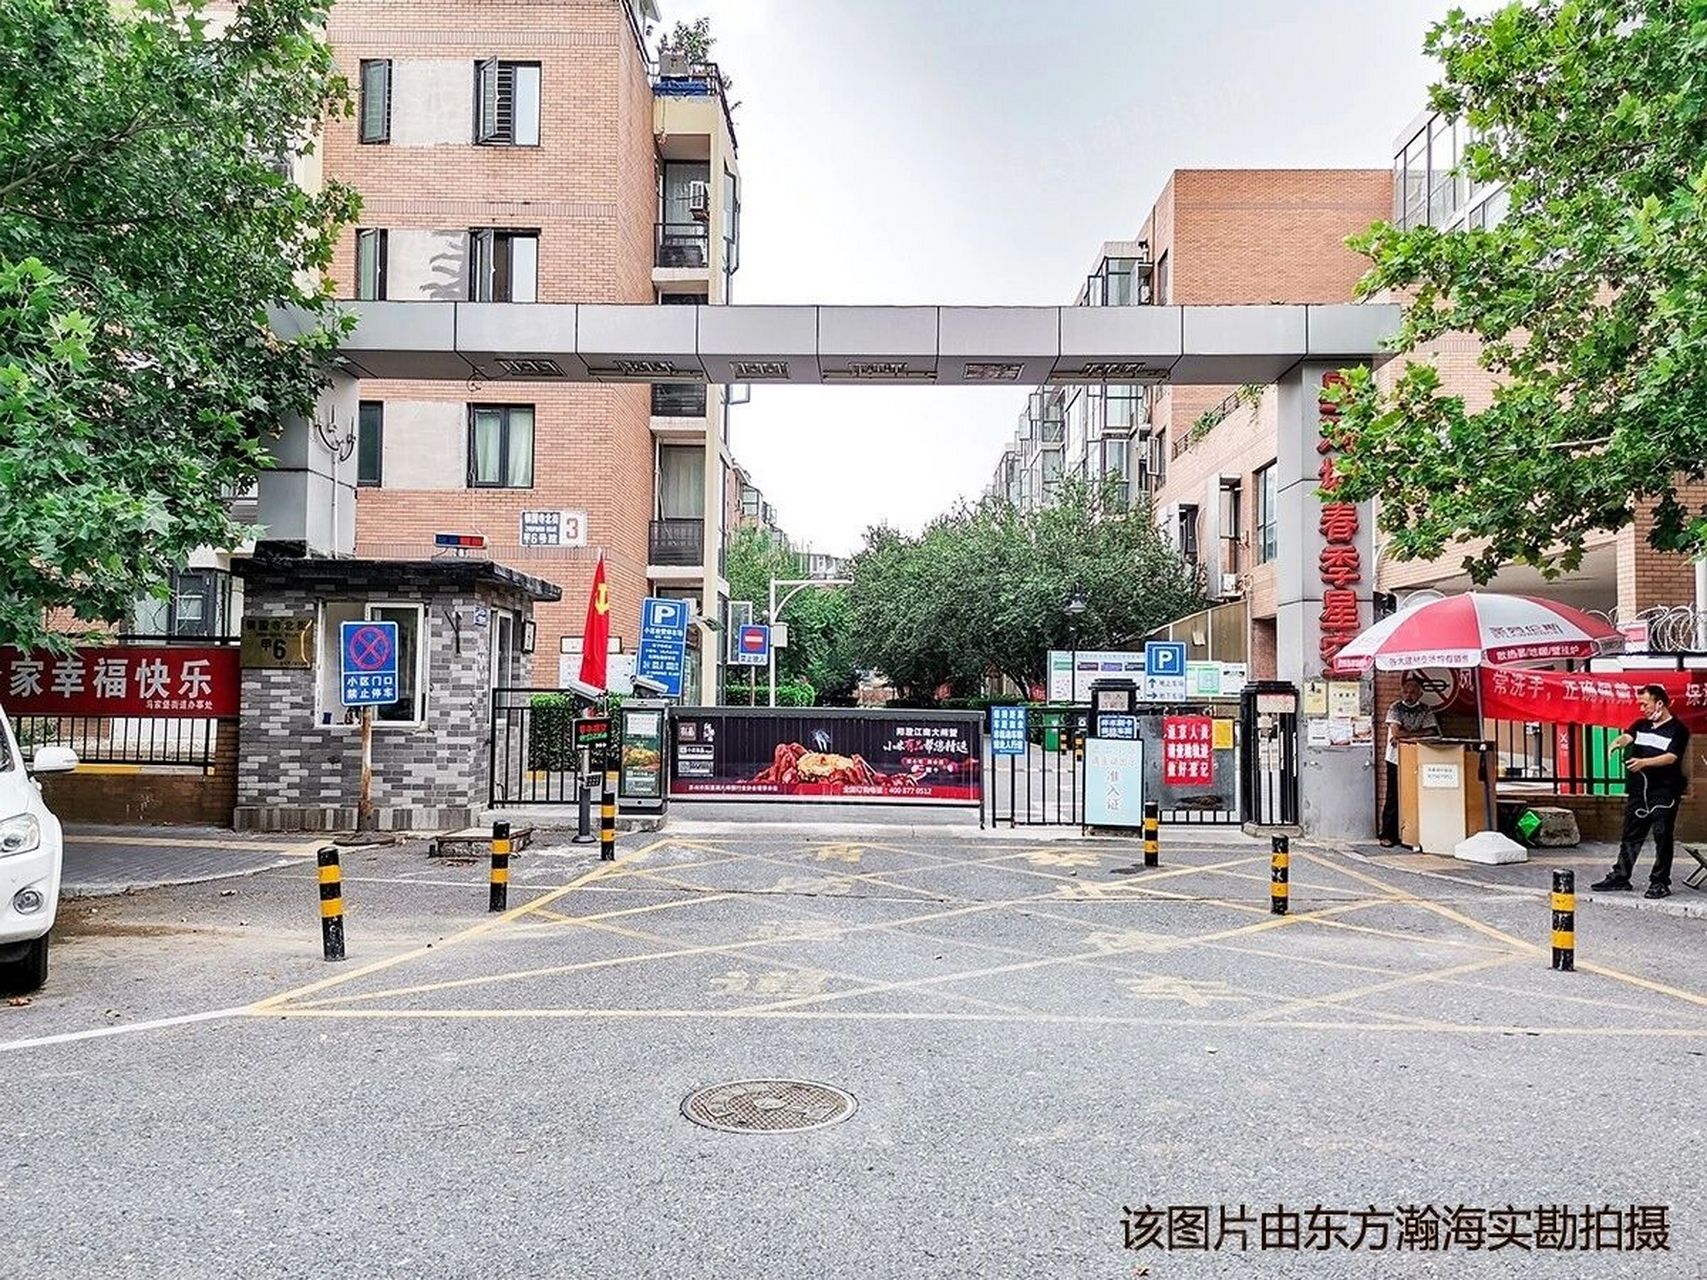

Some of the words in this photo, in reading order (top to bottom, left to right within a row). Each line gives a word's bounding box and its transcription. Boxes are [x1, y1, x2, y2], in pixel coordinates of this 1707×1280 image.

[566, 518, 578, 539] 3
[654, 605, 676, 624] P
[1159, 650, 1173, 669] P
[1, 657, 213, 698] 家幸福快乐
[347, 676, 393, 686] 小区门口
[347, 689, 393, 699] 禁止停车
